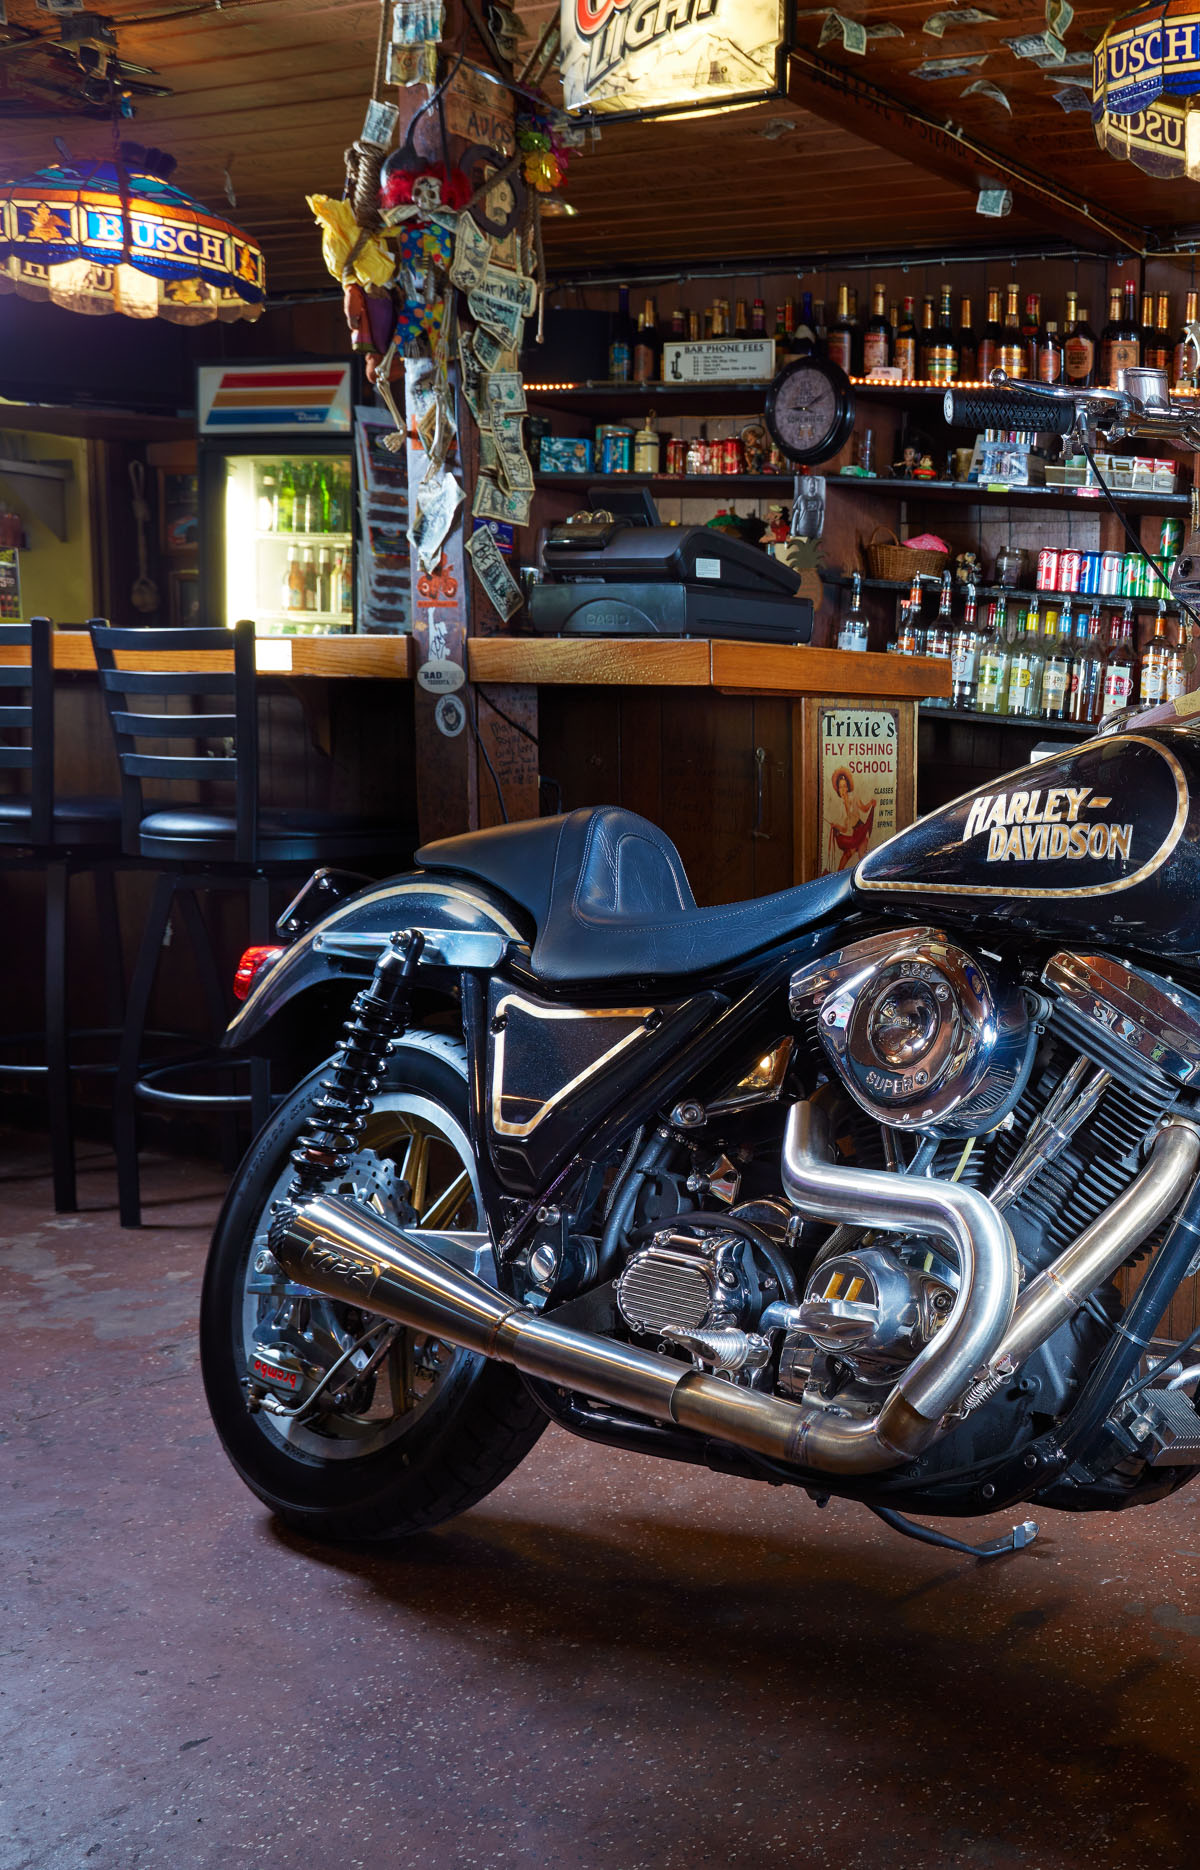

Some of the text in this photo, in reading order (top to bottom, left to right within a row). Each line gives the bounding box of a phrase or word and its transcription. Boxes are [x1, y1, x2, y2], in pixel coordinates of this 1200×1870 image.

[1097, 26, 1196, 87] BUSCH
[96, 213, 224, 263] BUSCH
[685, 343, 764, 354] BAR PHONE FEES
[586, 614, 630, 626] CASIO
[422, 671, 442, 680] BAD
[824, 714, 895, 738] Trixie's
[825, 743, 894, 756] FLY FISHING
[848, 760, 893, 774] SCHOOL
[874, 787, 894, 795] CLASSES
[963, 787, 1113, 842] HARLEY-
[877, 821, 893, 829] SPRING
[986, 823, 1134, 862] DAVIDSON
[866, 1071, 914, 1095] SUPER
[254, 1359, 297, 1389] brembo
